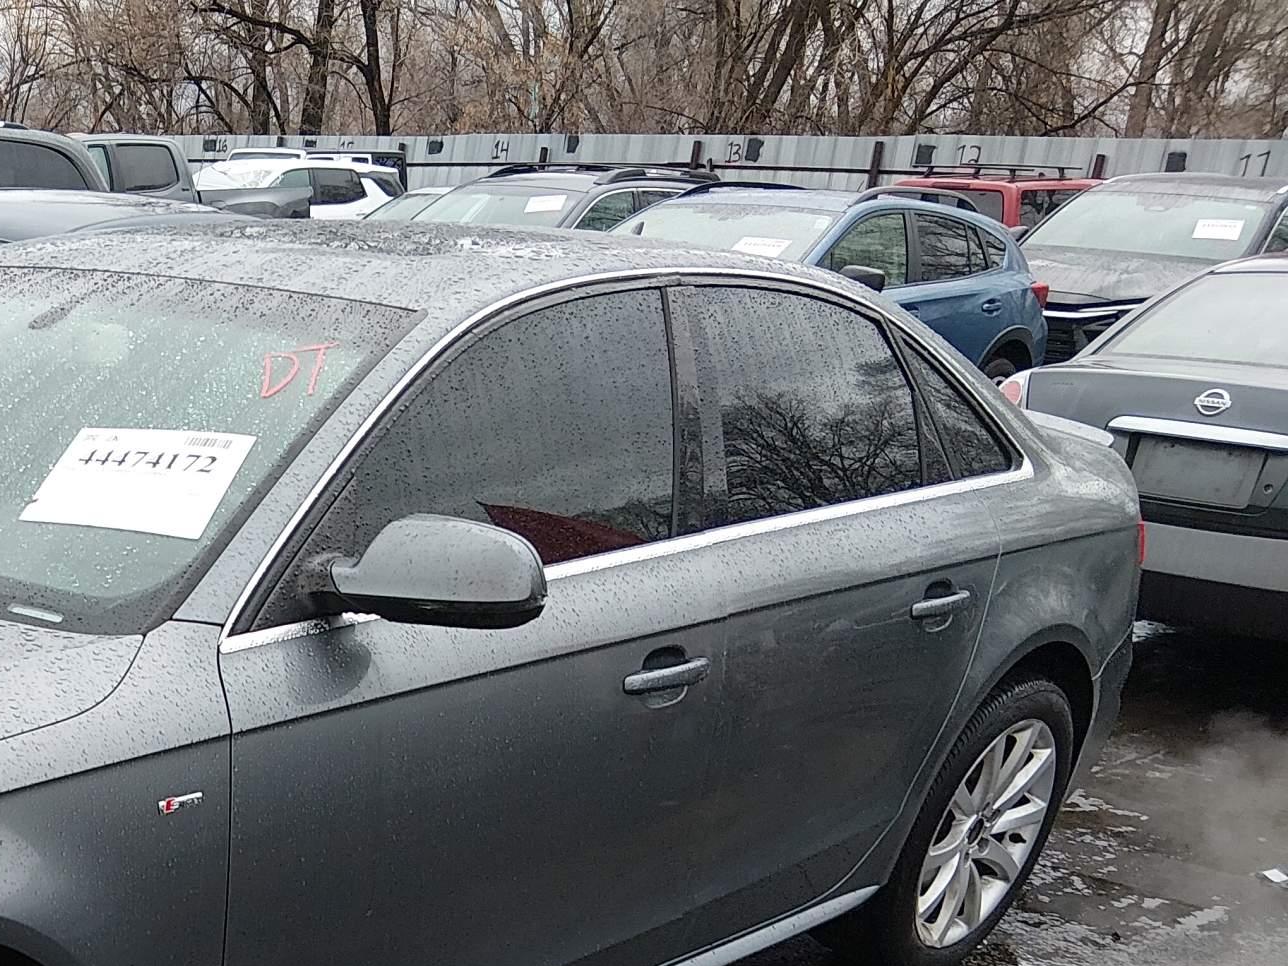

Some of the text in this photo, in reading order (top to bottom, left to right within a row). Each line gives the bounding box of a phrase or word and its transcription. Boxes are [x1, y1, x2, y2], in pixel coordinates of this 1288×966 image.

[216, 139, 229, 154] 16
[492, 140, 510, 160] 14
[725, 142, 742, 163] 13
[957, 144, 982, 165] 12
[260, 342, 340, 399] DT
[78, 449, 217, 473] 44474172
